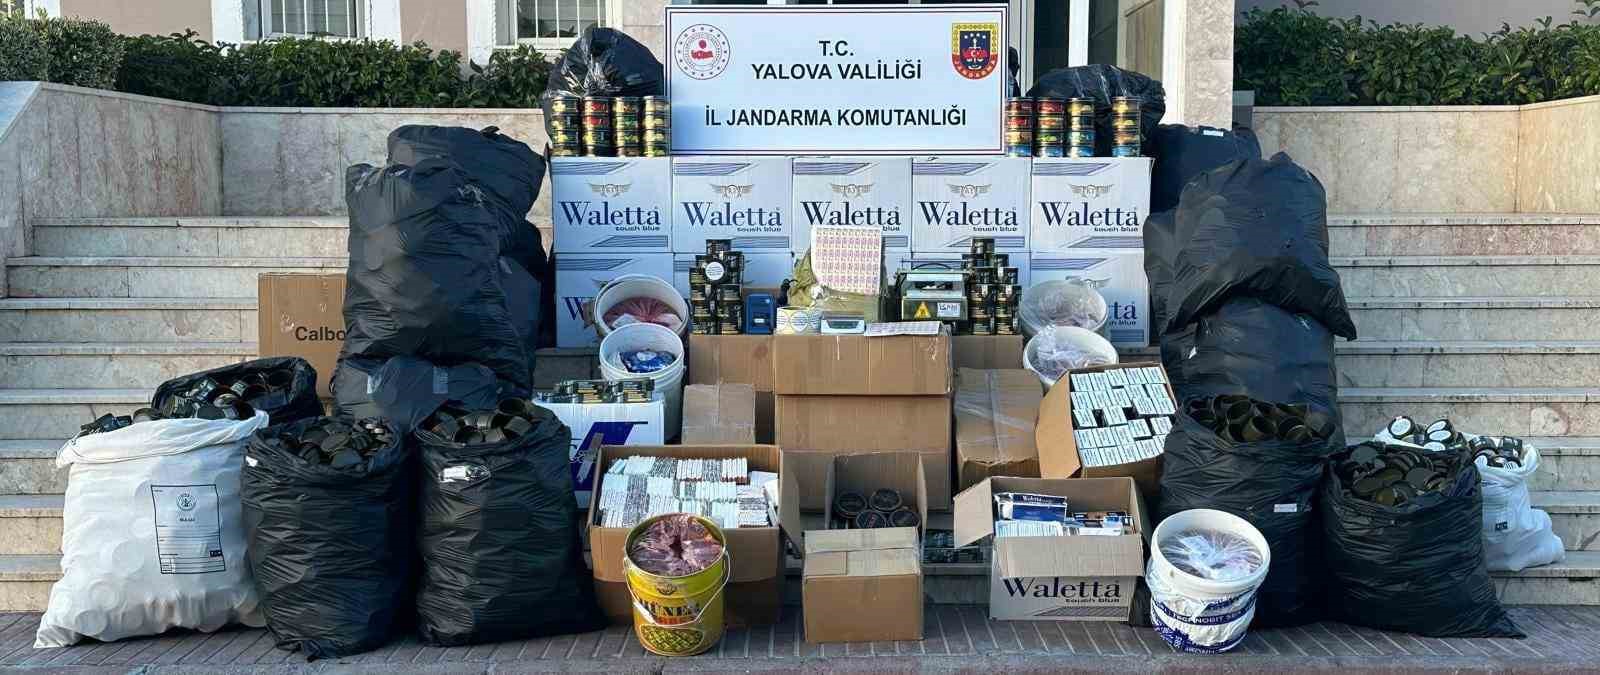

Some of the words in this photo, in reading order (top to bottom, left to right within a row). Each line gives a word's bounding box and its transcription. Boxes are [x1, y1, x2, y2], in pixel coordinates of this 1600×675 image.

[818, 40, 854, 57] T.C.
[751, 63, 833, 80] YALOVA
[838, 59, 921, 80] VALİLİĞİ
[705, 105, 722, 126] İL
[727, 109, 833, 126] JANDARMA
[837, 104, 966, 126] KOMUTANLIĞI
[558, 201, 660, 226] Waletta
[680, 201, 782, 227] Waletta
[800, 201, 902, 226] Waletta
[918, 201, 1018, 226] Waletta
[1039, 201, 1139, 227] Waletta
[1002, 577, 1121, 599] Waletta
